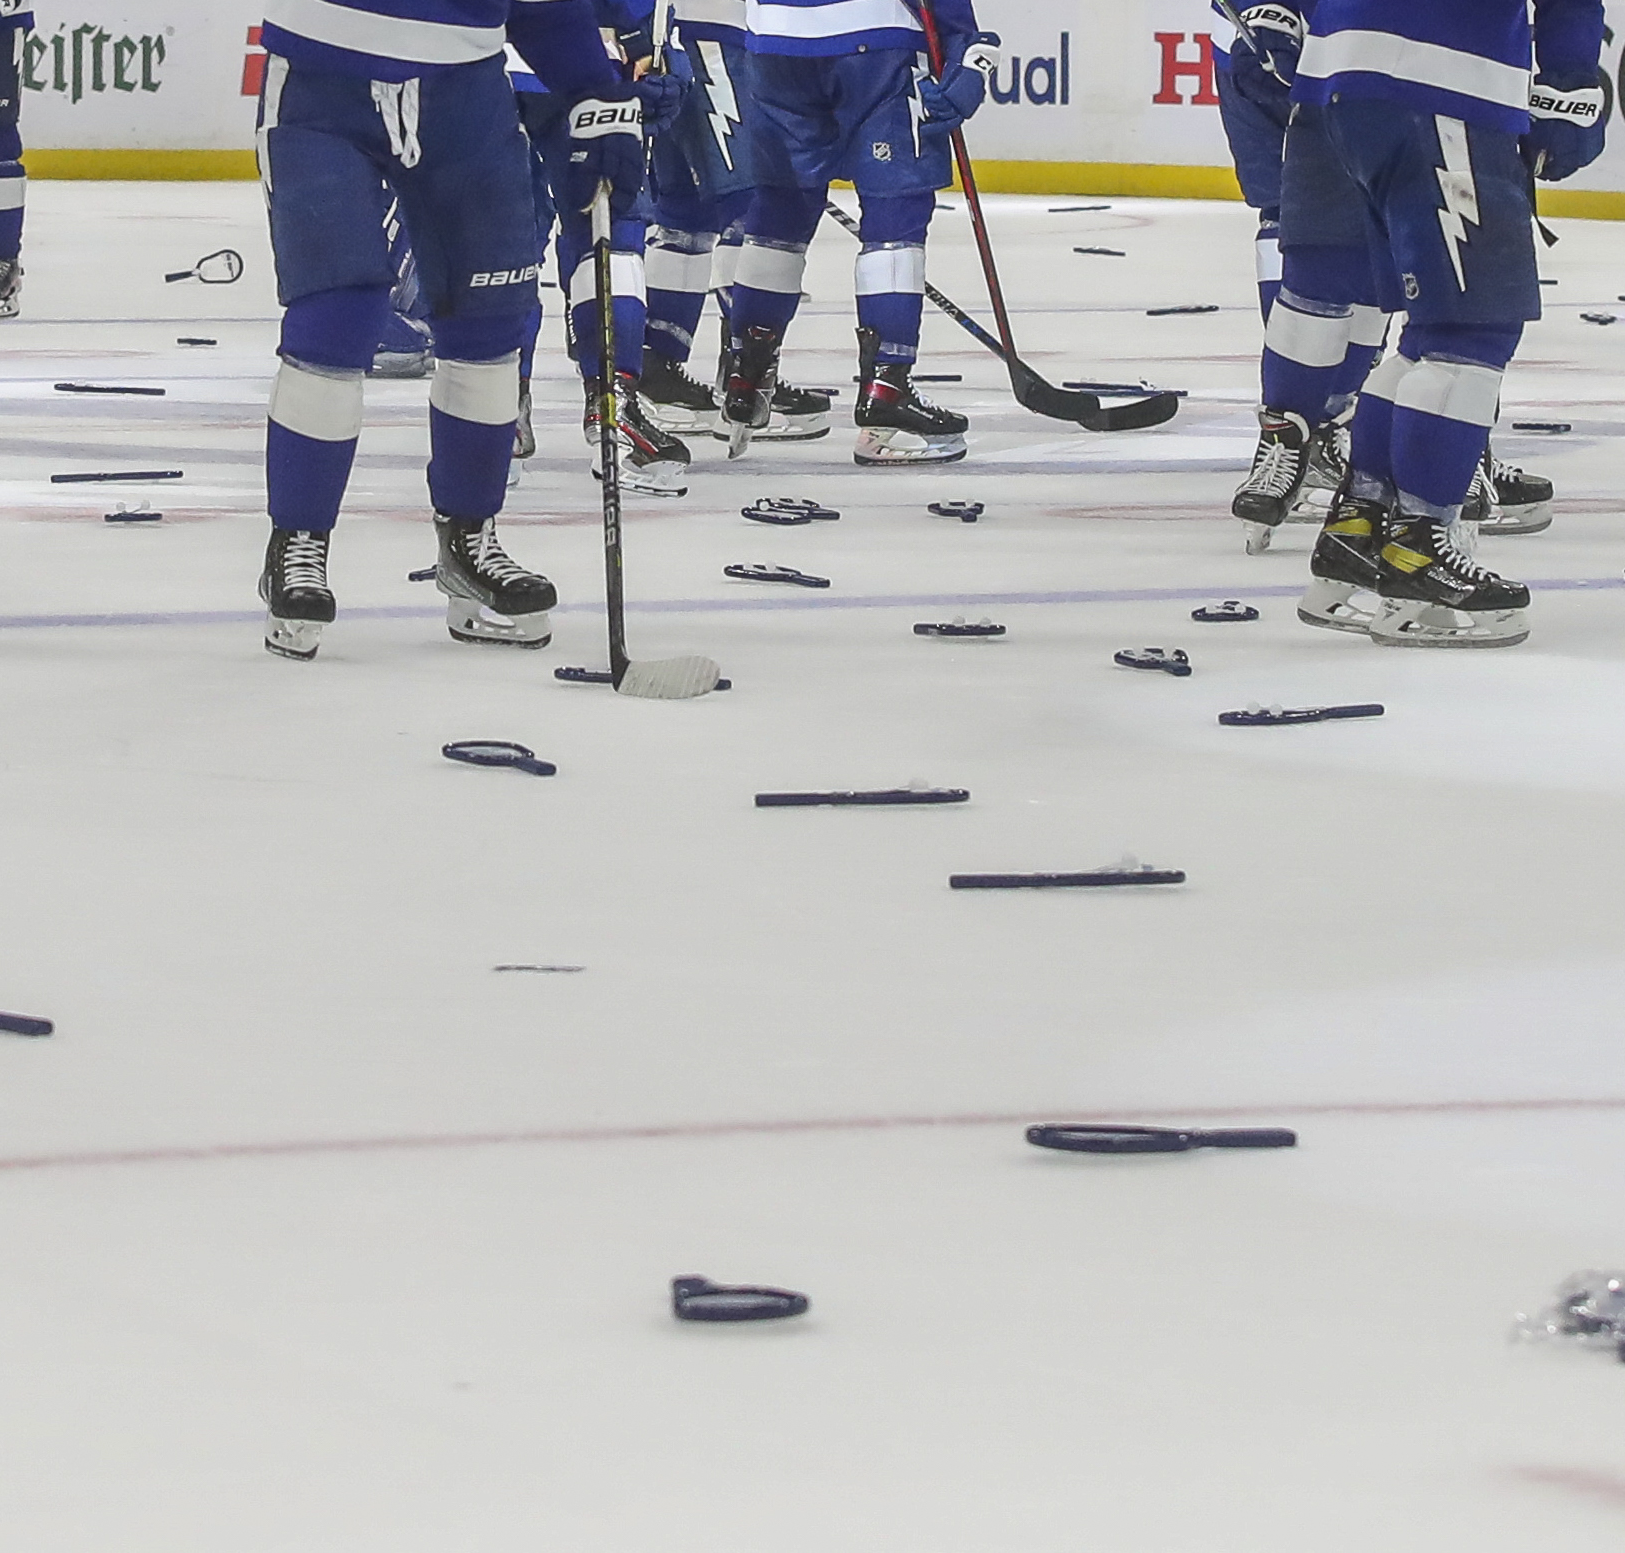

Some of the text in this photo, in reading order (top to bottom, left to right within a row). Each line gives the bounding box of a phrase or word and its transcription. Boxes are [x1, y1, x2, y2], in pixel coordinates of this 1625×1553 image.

[985, 31, 1070, 106] ual
[1528, 94, 1598, 118] BAUER
[469, 264, 539, 289] BAUE
